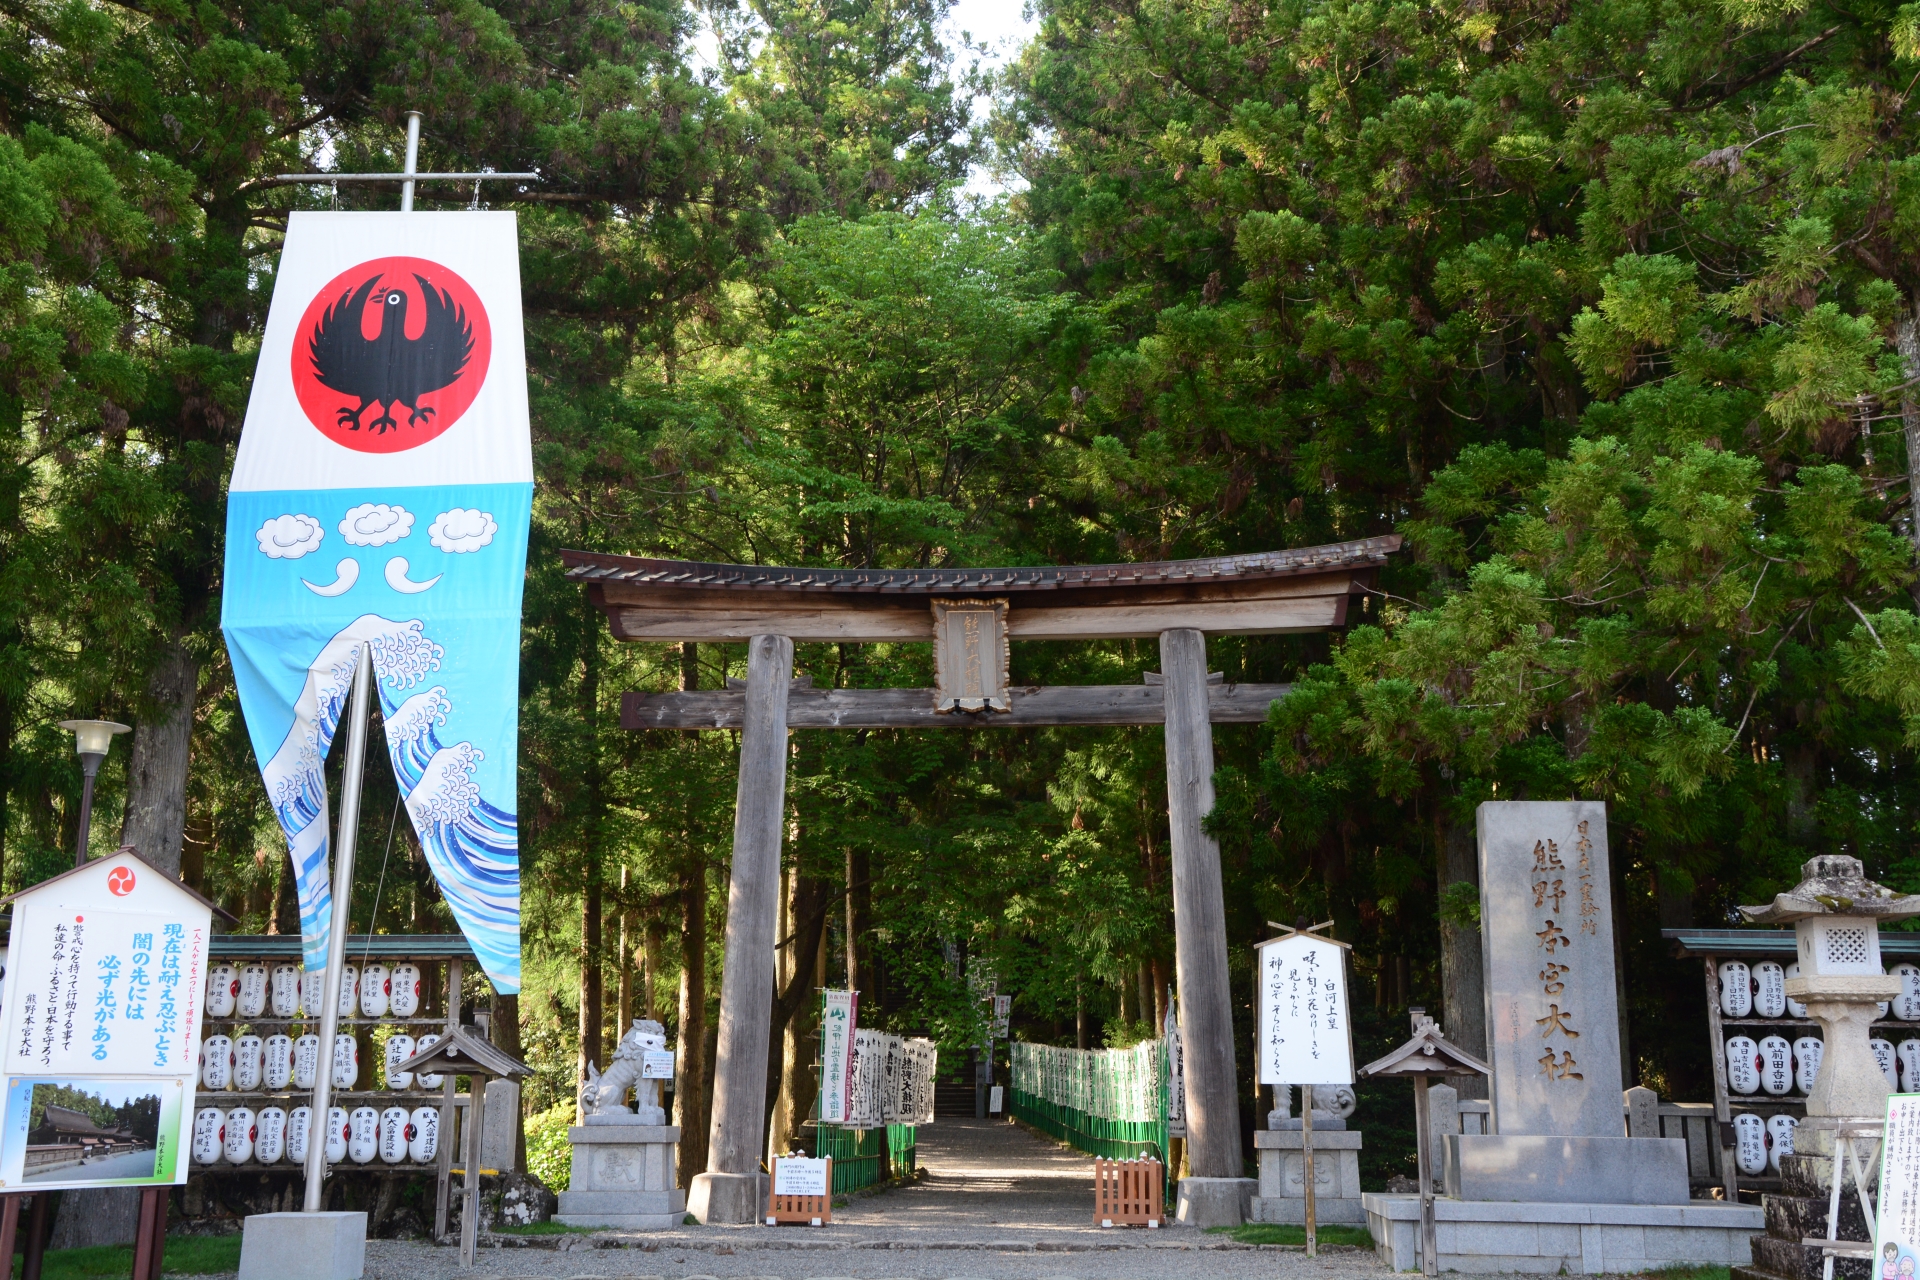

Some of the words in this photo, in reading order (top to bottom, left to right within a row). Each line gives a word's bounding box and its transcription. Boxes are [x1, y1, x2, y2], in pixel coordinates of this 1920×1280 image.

[125, 933, 153, 1020] 闇の先には
[153, 923, 185, 1067] 現在は耐え忍ぶとき
[1288, 969, 1301, 1018] 見るからに
[1531, 838, 1584, 1081] 熊野本宮大社
[18, 993, 37, 1057] 熊野本宮大社
[91, 955, 122, 1061] 必ず光がある
[1324, 979, 1339, 1030] 白河上皇
